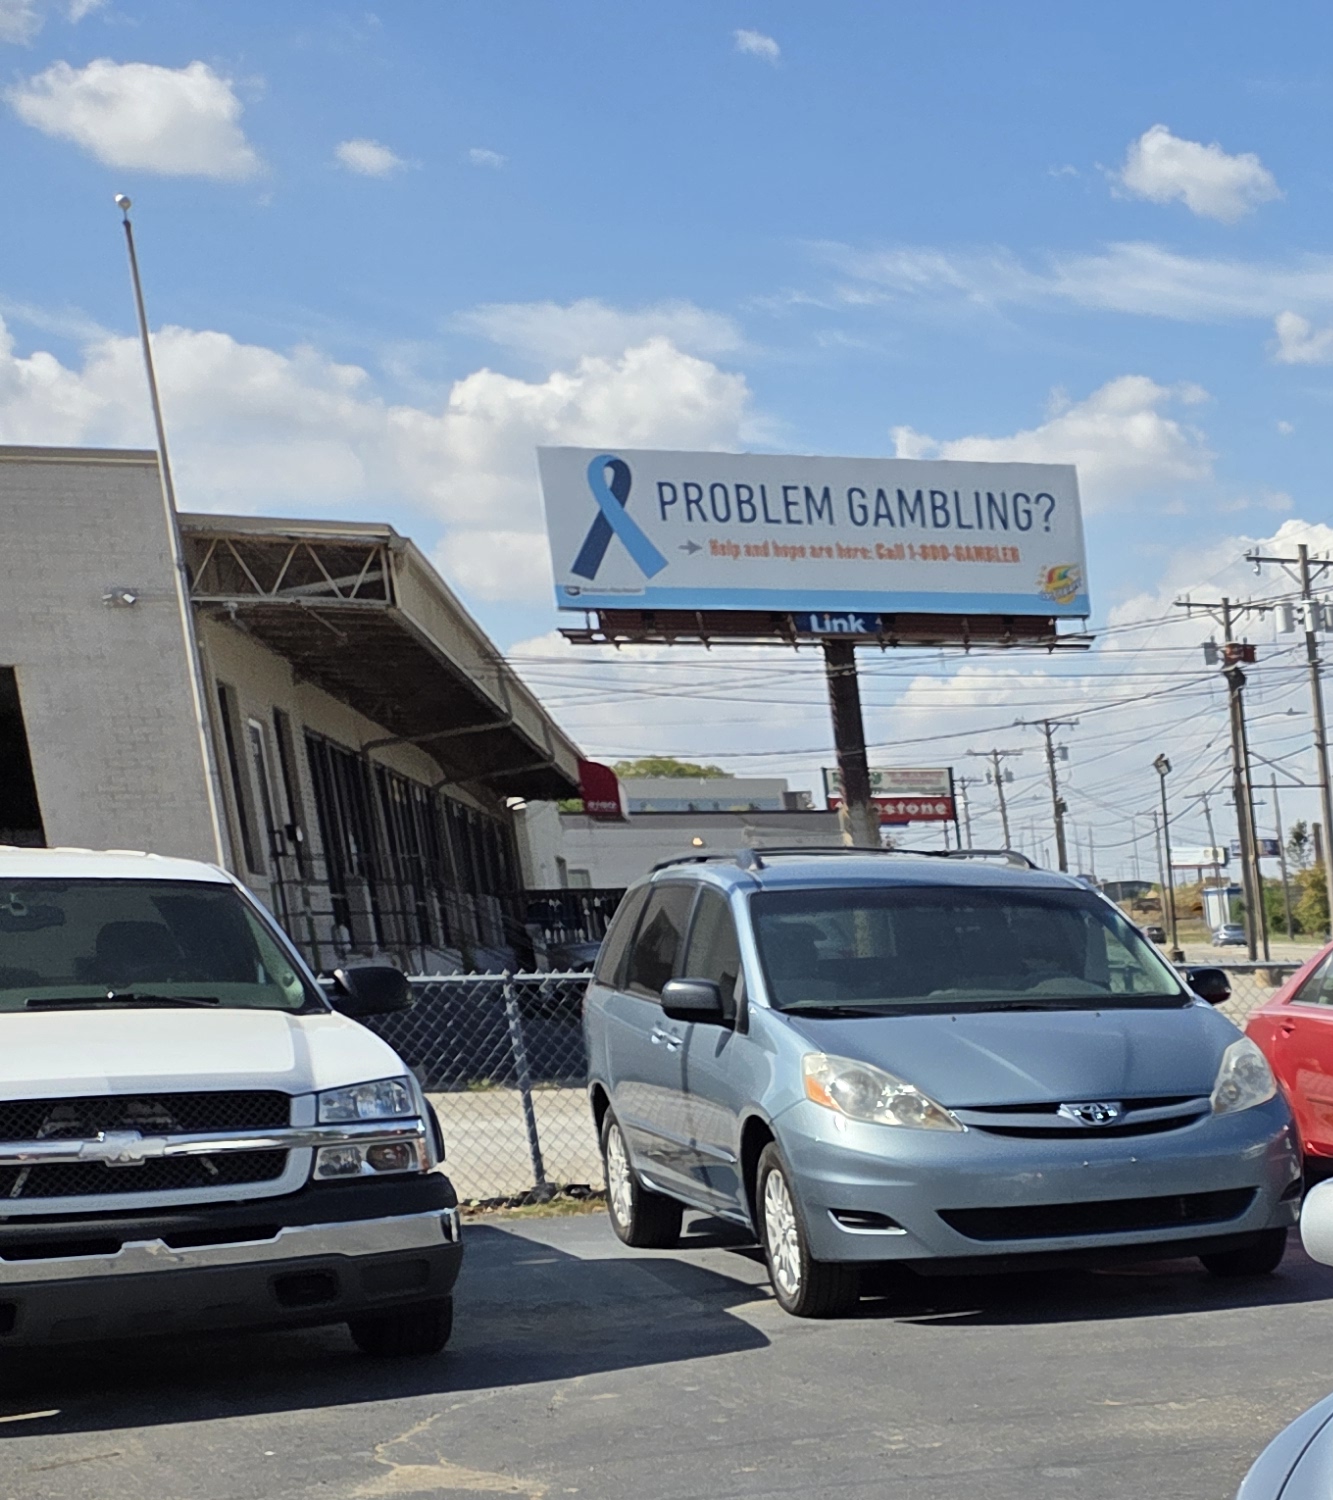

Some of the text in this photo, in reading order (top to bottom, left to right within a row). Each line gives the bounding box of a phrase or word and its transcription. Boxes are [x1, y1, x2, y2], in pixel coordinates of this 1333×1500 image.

[657, 481, 1056, 532] PROBLEM GAMBLING?
[709, 539, 741, 560] Help
[744, 540, 769, 557] and
[772, 539, 806, 561] hope
[810, 544, 833, 558] are
[875, 542, 905, 560] Call
[907, 543, 1021, 563] 1-800-GAMBLER
[809, 613, 867, 633] Link
